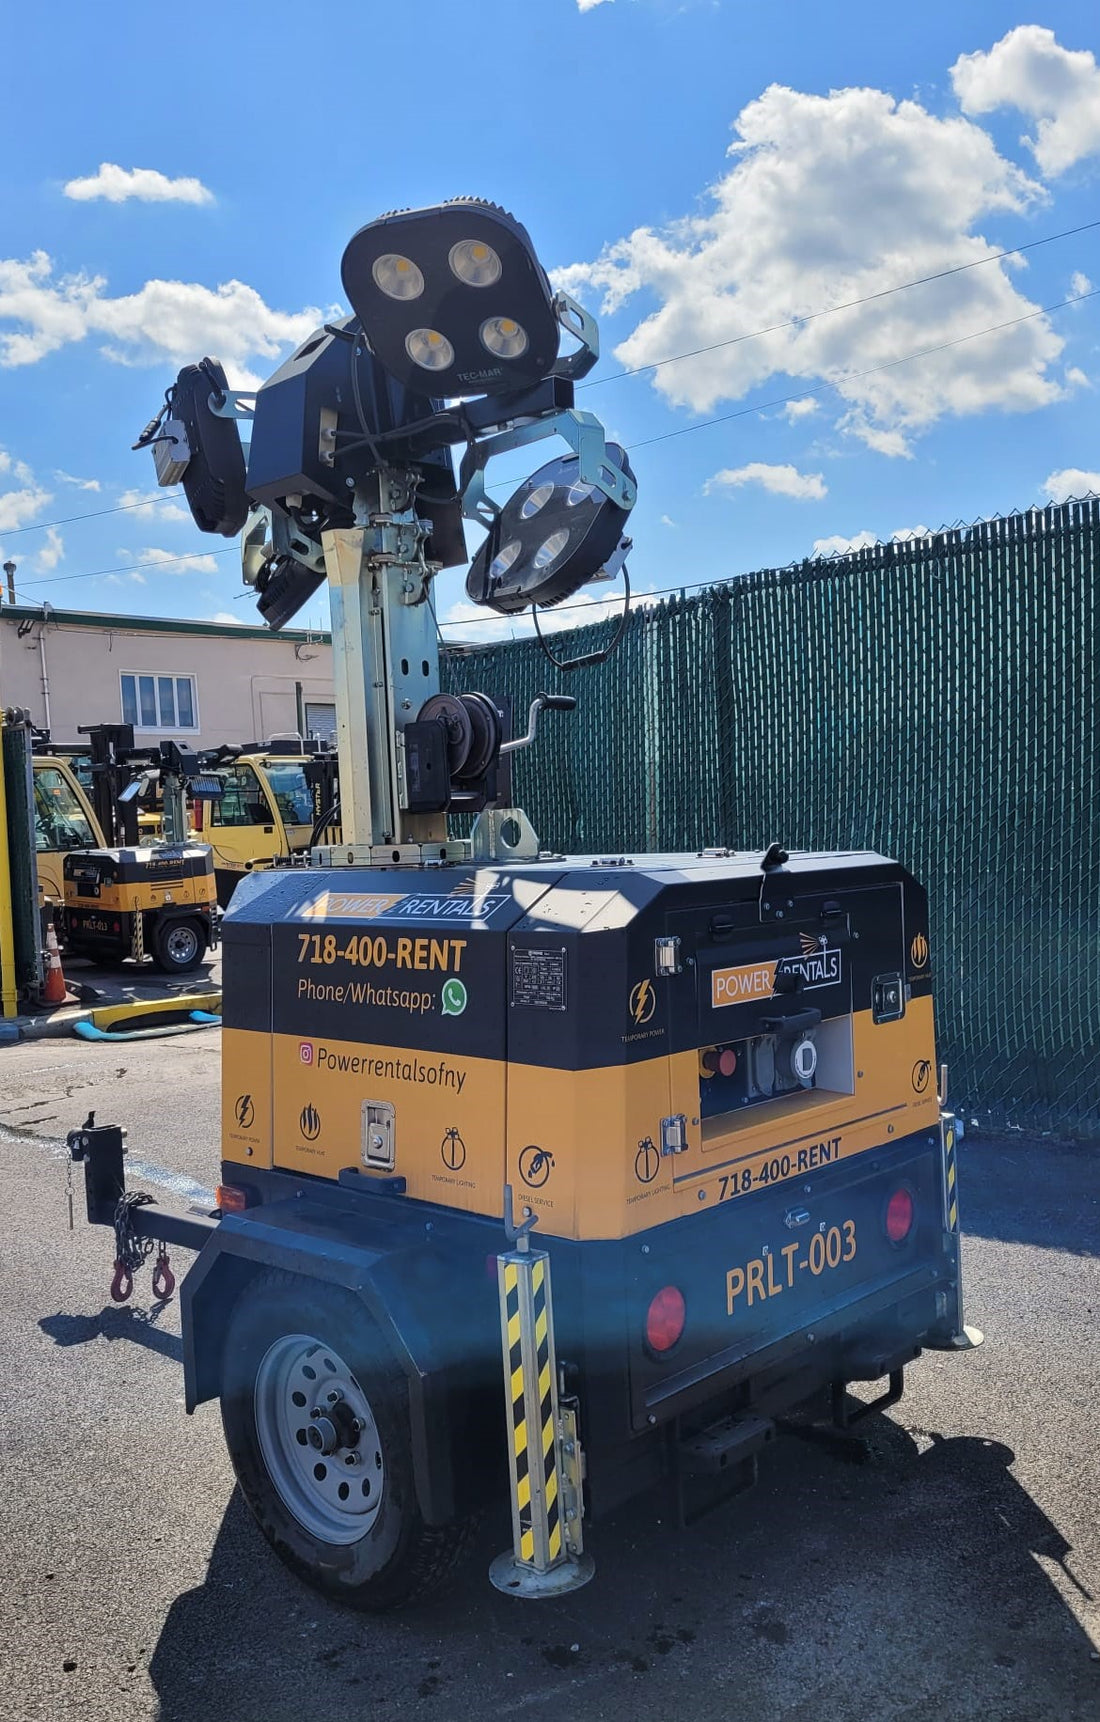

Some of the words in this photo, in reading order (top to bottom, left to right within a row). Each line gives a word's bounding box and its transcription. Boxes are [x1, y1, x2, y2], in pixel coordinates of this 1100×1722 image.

[457, 368, 502, 382] TEC-MAR
[399, 899, 495, 916] RENTALS
[298, 934, 468, 971] 718-400-RENT
[298, 979, 436, 1015] Phone/Whatsapp:
[716, 970, 773, 999] POWER
[317, 1048, 466, 1094] Powerrentalsofny
[718, 1137, 842, 1200] 718-400-RENT
[726, 1219, 857, 1316] PRLT-003
